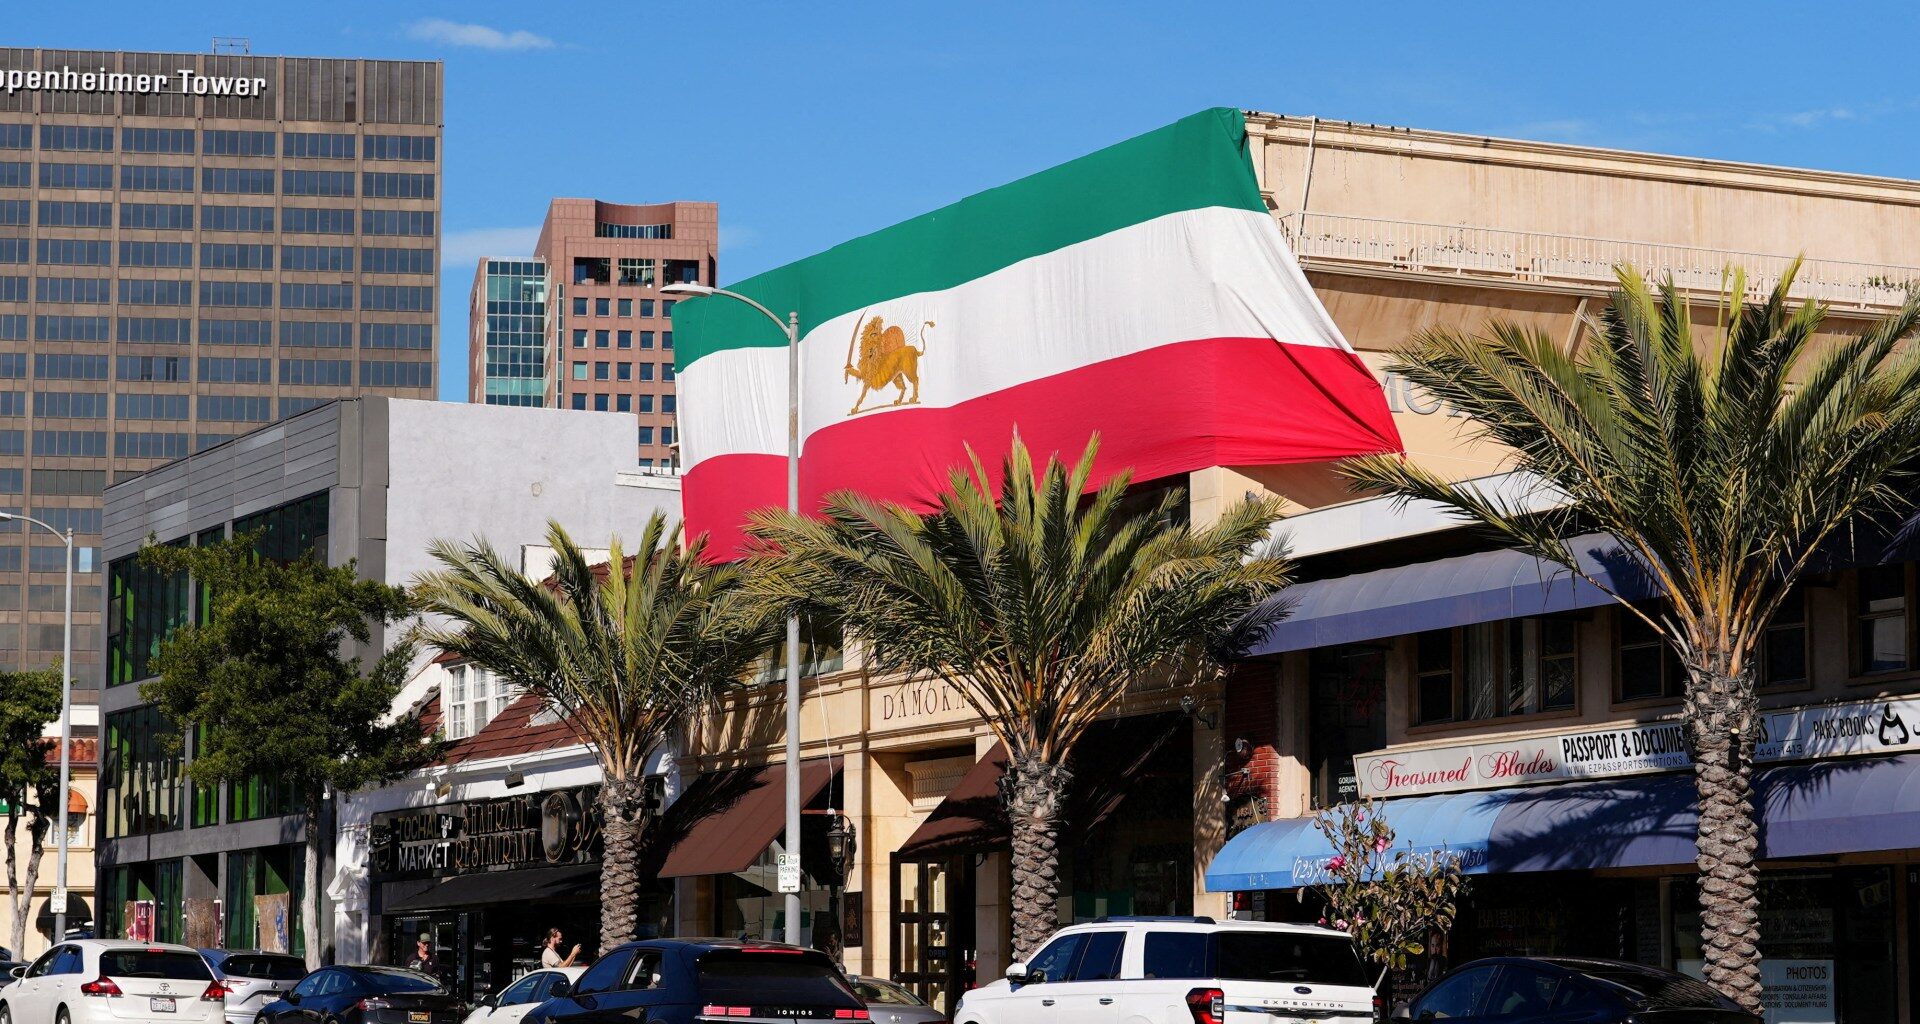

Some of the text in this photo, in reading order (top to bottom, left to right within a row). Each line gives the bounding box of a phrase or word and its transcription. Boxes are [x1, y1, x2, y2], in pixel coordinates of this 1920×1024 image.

[0, 66, 267, 97] penheimer Tower
[1813, 715, 1874, 740] PARS BOOKS
[1562, 727, 1684, 764] PASSPORT & DOCUME
[1754, 744, 1803, 757] -441-1413
[1367, 749, 1558, 791] Treasured Blades
[398, 813, 441, 842] TOCHAL
[462, 799, 529, 836] SHAHRZAD
[398, 842, 450, 872] MARKET
[455, 832, 536, 868] RESTAURANT
[779, 855, 785, 865] 2
[1786, 966, 1827, 980] PHOTOS
[1263, 1000, 1344, 1008] EXPEDITION
